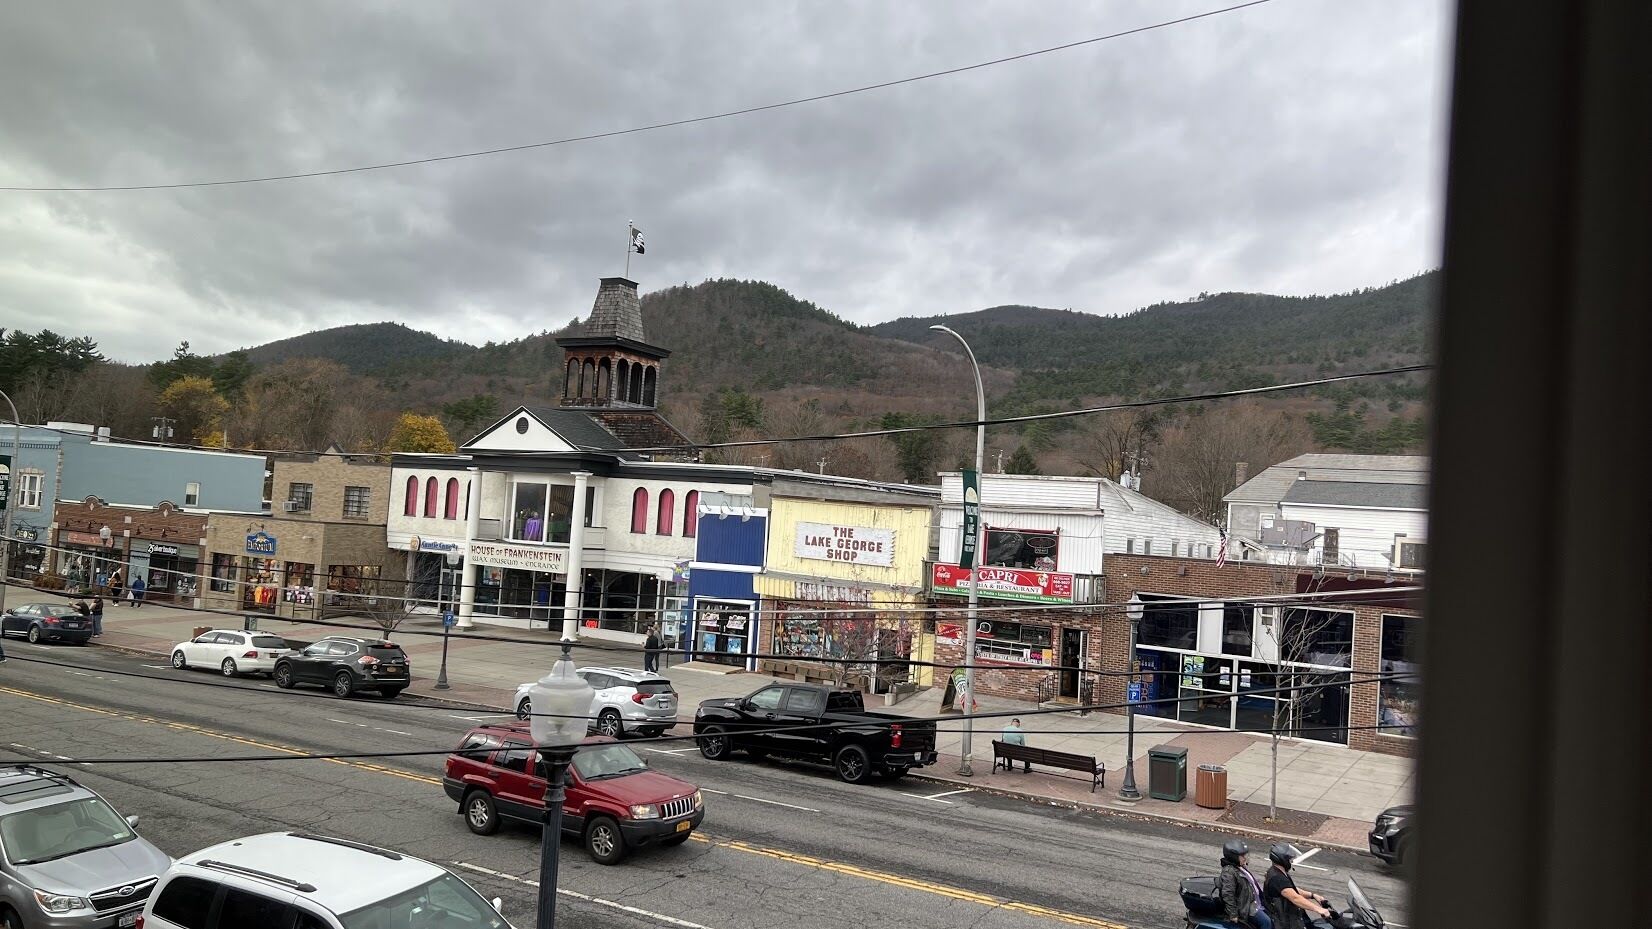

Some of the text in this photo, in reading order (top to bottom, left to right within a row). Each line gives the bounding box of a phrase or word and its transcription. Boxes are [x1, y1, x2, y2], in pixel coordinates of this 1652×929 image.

[833, 527, 854, 538] THE
[805, 535, 883, 553] LAKE GEORGE
[471, 545, 495, 556] HOUSE
[504, 548, 562, 562] FRANKENSTEIN
[826, 549, 858, 561] SHOP
[978, 569, 1019, 584] CAPRI
[959, 581, 988, 589] PIZRIA
[996, 584, 1040, 593] RESTAURANT
